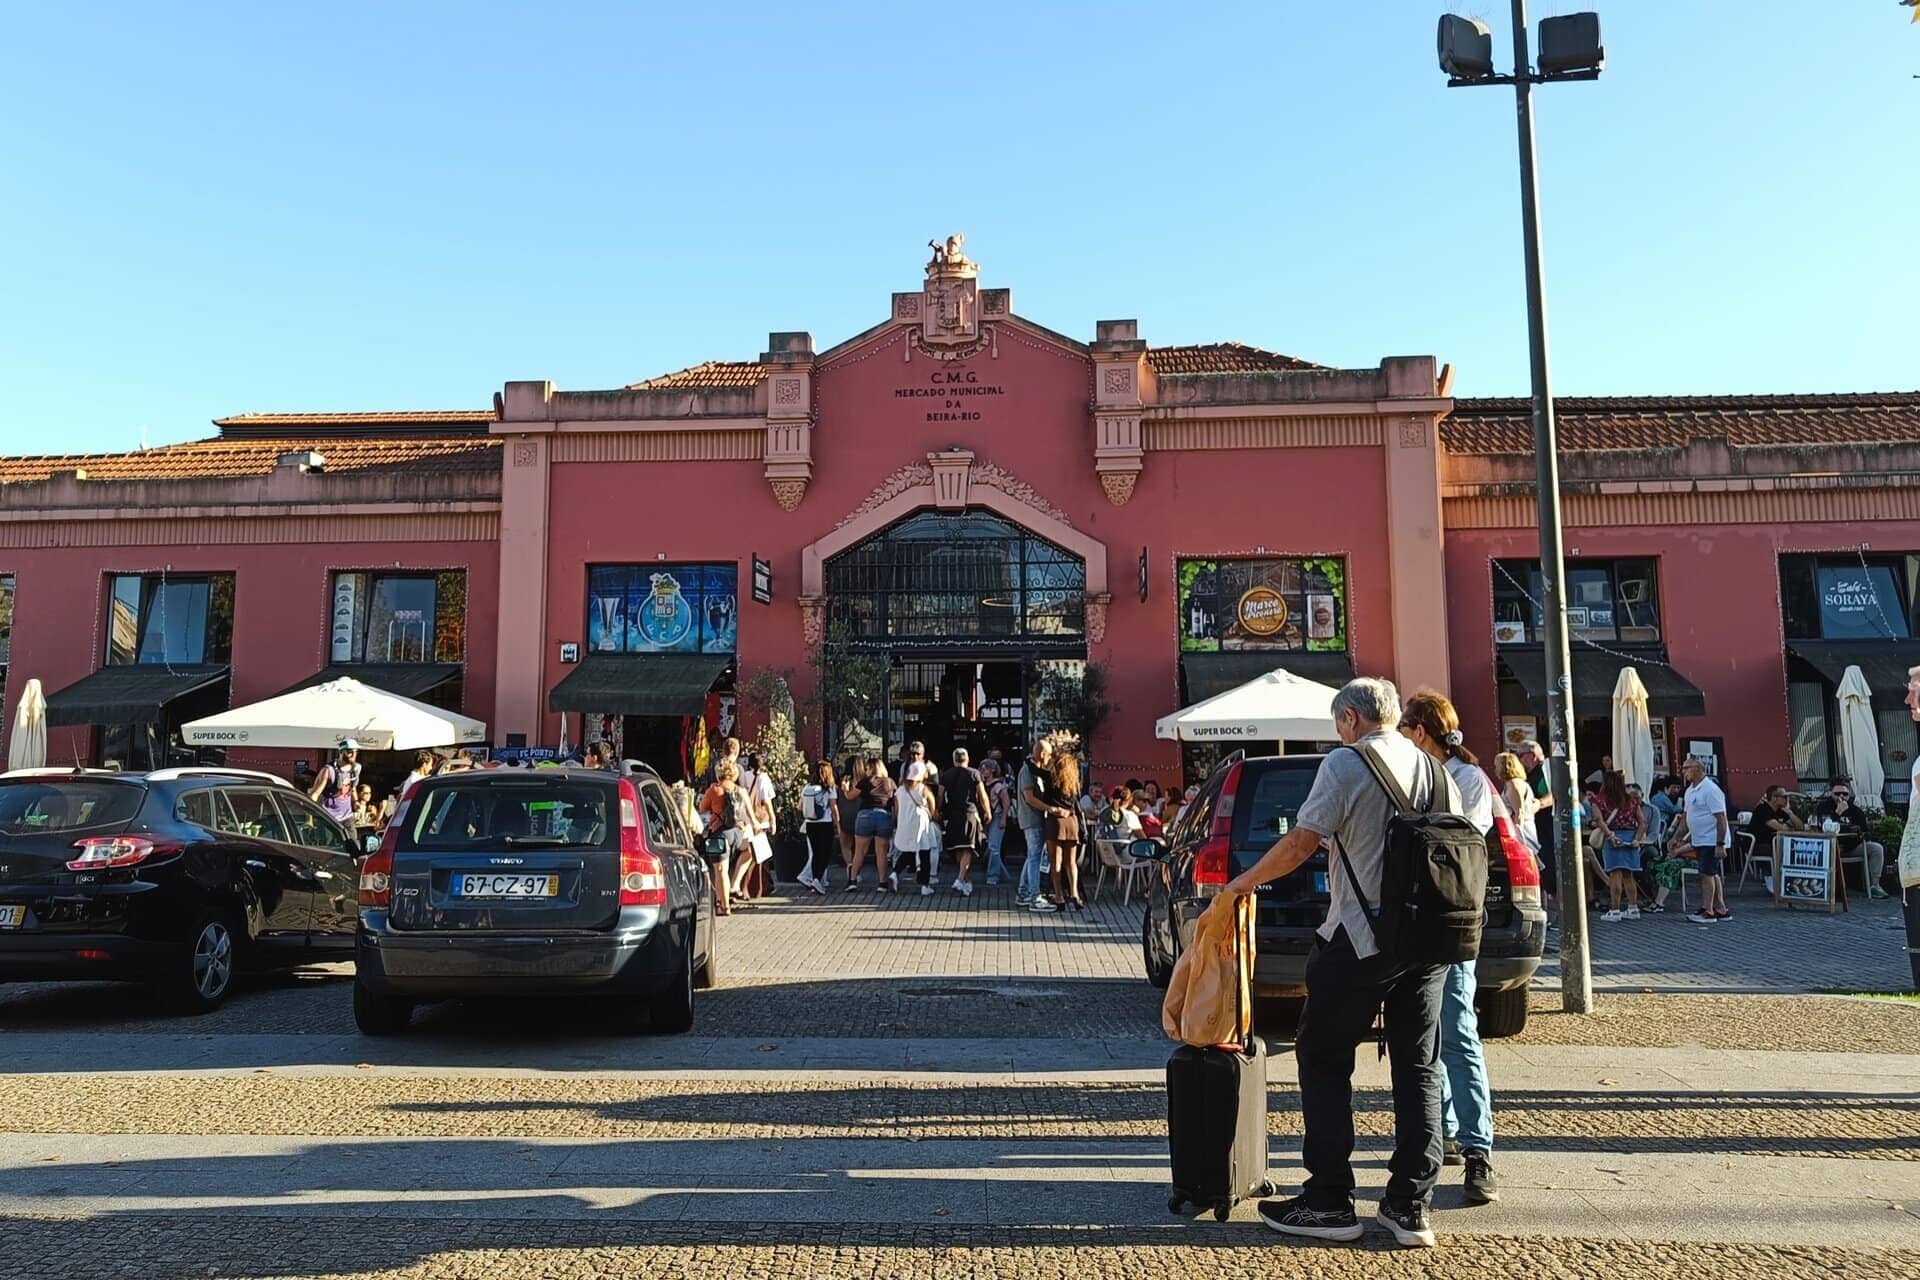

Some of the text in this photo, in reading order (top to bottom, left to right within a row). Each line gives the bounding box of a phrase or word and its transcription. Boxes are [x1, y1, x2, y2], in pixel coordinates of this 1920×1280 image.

[895, 386, 1004, 398] MERCADO MUNICIPAL
[945, 400, 961, 409] DA
[926, 412, 981, 422] BEIRA-RIO
[1244, 598, 1279, 612] Marco
[1824, 594, 1877, 606] SORAYA
[192, 731, 215, 740] SUPER
[216, 731, 236, 740] BOCK
[1193, 727, 1218, 736] SUPER
[1220, 726, 1243, 736] BOCK
[519, 748, 555, 758] FC PORTO
